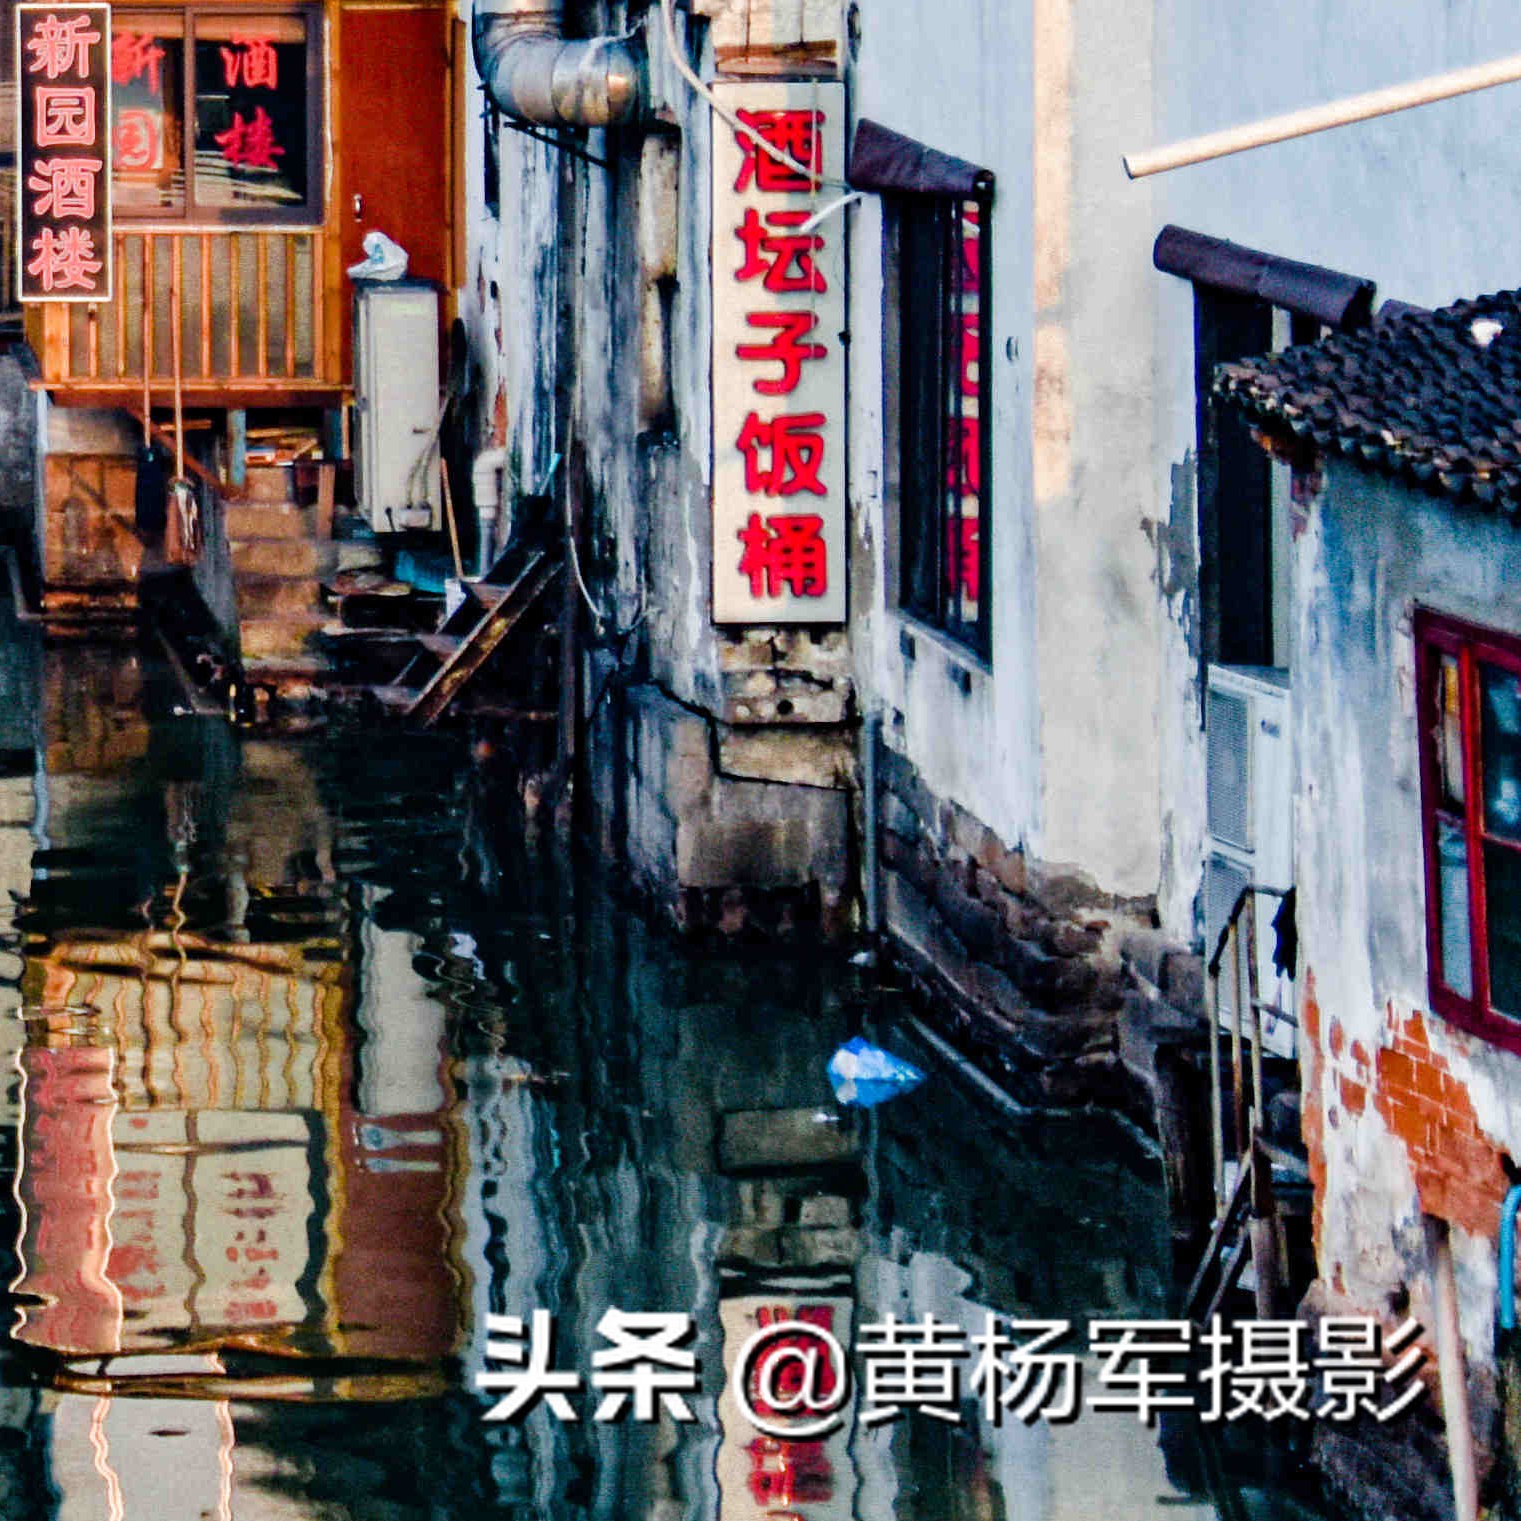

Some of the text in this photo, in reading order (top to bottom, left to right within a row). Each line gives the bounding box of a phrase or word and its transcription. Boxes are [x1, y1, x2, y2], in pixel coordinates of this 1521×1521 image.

[27, 13, 104, 293] 新园酒楼
[733, 106, 828, 598] 酒坛子饭桶
